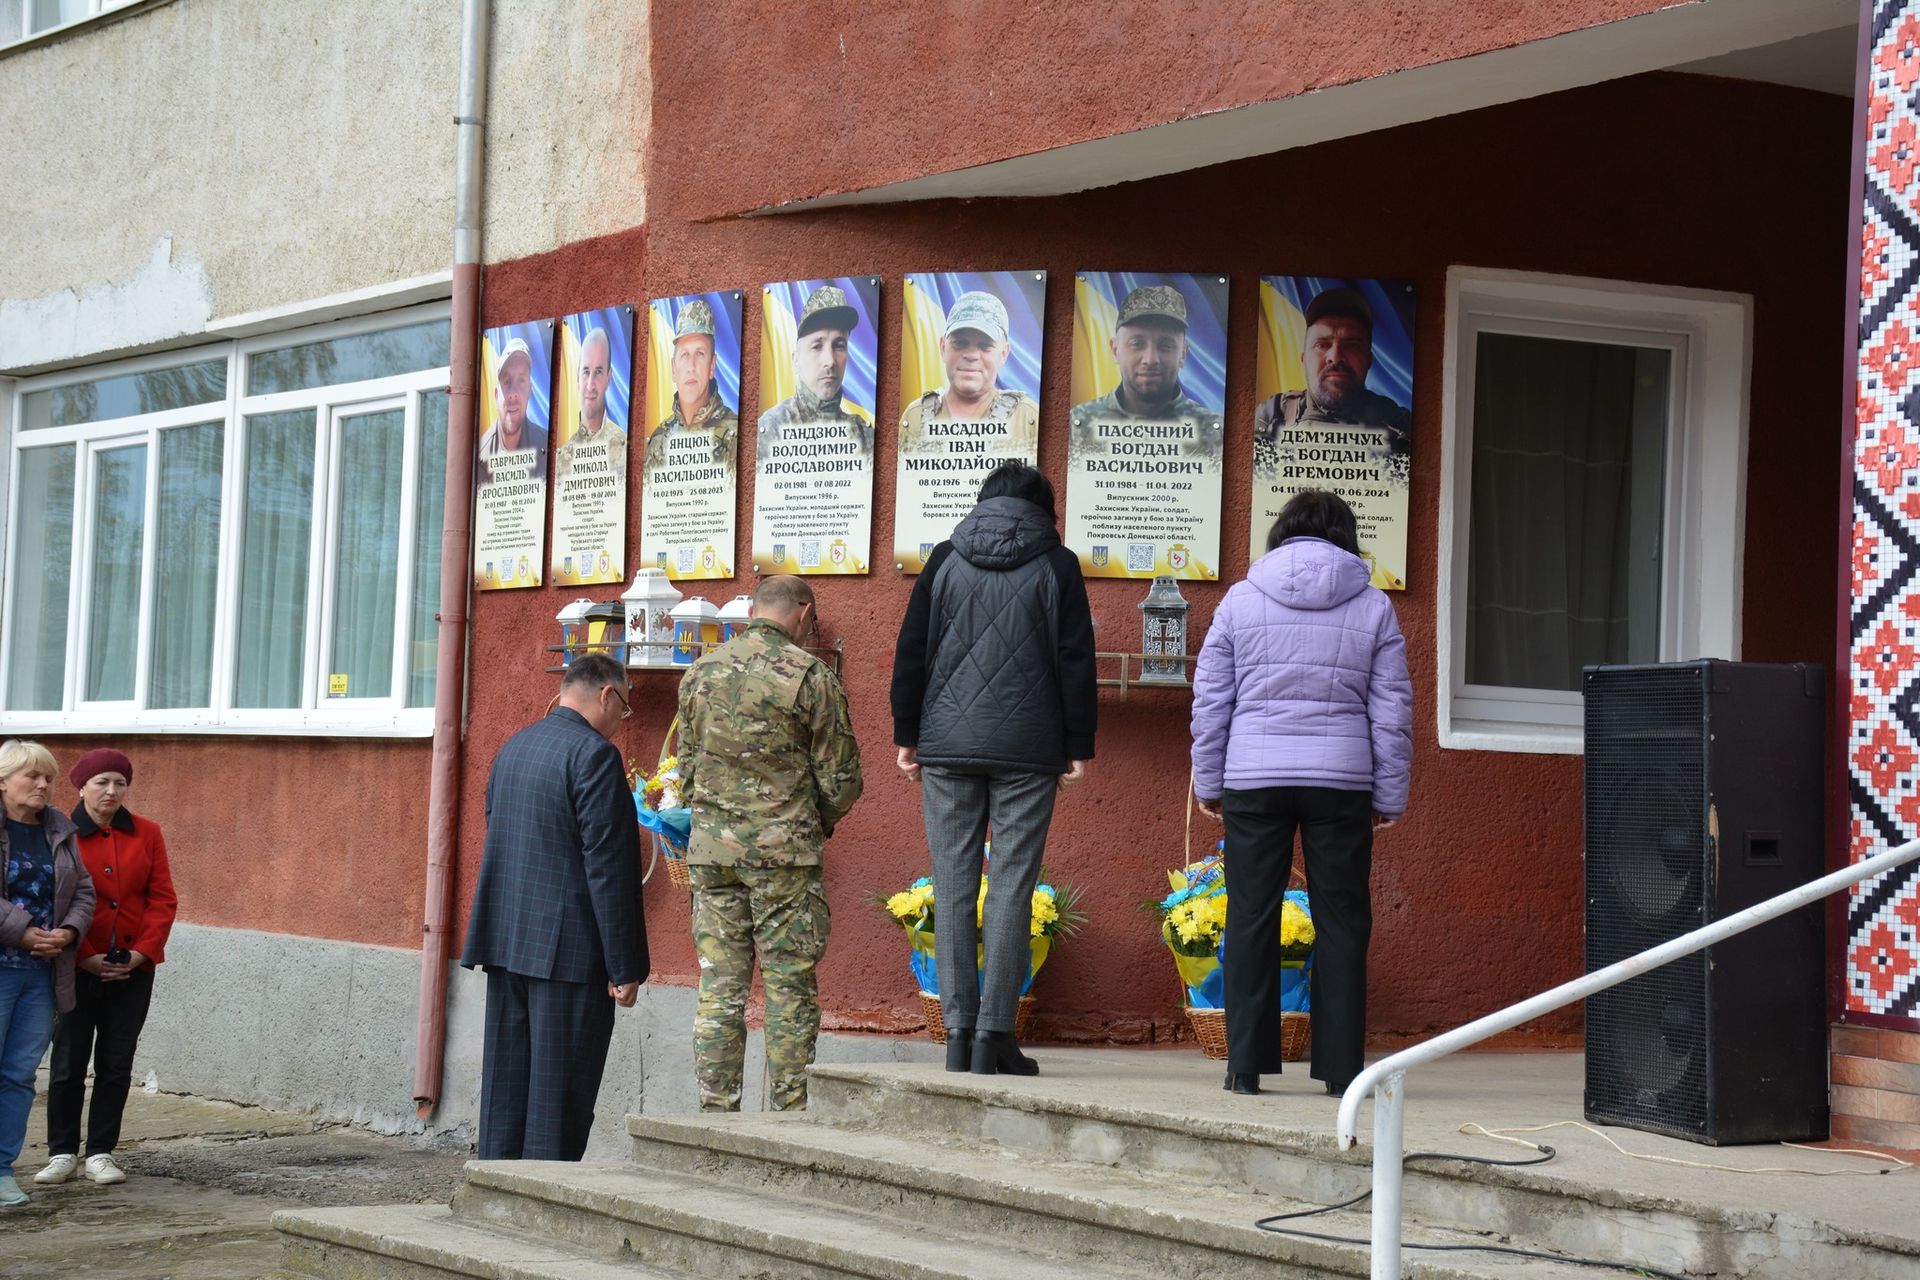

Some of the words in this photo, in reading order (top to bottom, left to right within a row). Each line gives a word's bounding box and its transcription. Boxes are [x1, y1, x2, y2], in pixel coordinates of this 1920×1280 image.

[782, 426, 847, 441] ГАНДЗЮК
[928, 423, 1007, 437] НАСАДЮК
[1098, 423, 1194, 438] ПАСЄЧНИЙ
[669, 436, 710, 450] ЯНЦЮК
[949, 441, 986, 453] ІВАН
[1111, 442, 1179, 457] БОГДАН
[575, 445, 606, 459] ЯНЦЮК
[772, 443, 857, 458] ВОЛОДИМИР
[1298, 448, 1366, 464] БОГДАН
[490, 453, 534, 468] ГАВРИЛЮК
[669, 453, 710, 466] ВАСИЛЬ
[905, 455, 1028, 471] МИКОЛАЙОВЧ
[573, 461, 608, 474] МИКОЛА
[765, 460, 863, 474] ЯРОСЛАВОВИЧ
[1086, 460, 1203, 474] ВАСИЛЬОВИЧ
[1282, 466, 1380, 481] ЯРЕМОВИЧ
[496, 470, 527, 482] ВАСИЛЬ
[654, 468, 724, 483] ВАСИЛЬОВИЧ
[482, 483, 540, 499] ЯРОСЛАВОВИЧ
[564, 476, 615, 493] ДМИТРОВИЧ
[1094, 480, 1137, 489] 31.10.1984
[1107, 494, 1149, 502] Випускник
[1332, 488, 1389, 497] 30.06.2024
[810, 503, 839, 511] молодший
[1176, 516, 1204, 524] Україну
[1167, 533, 1196, 541] області.
